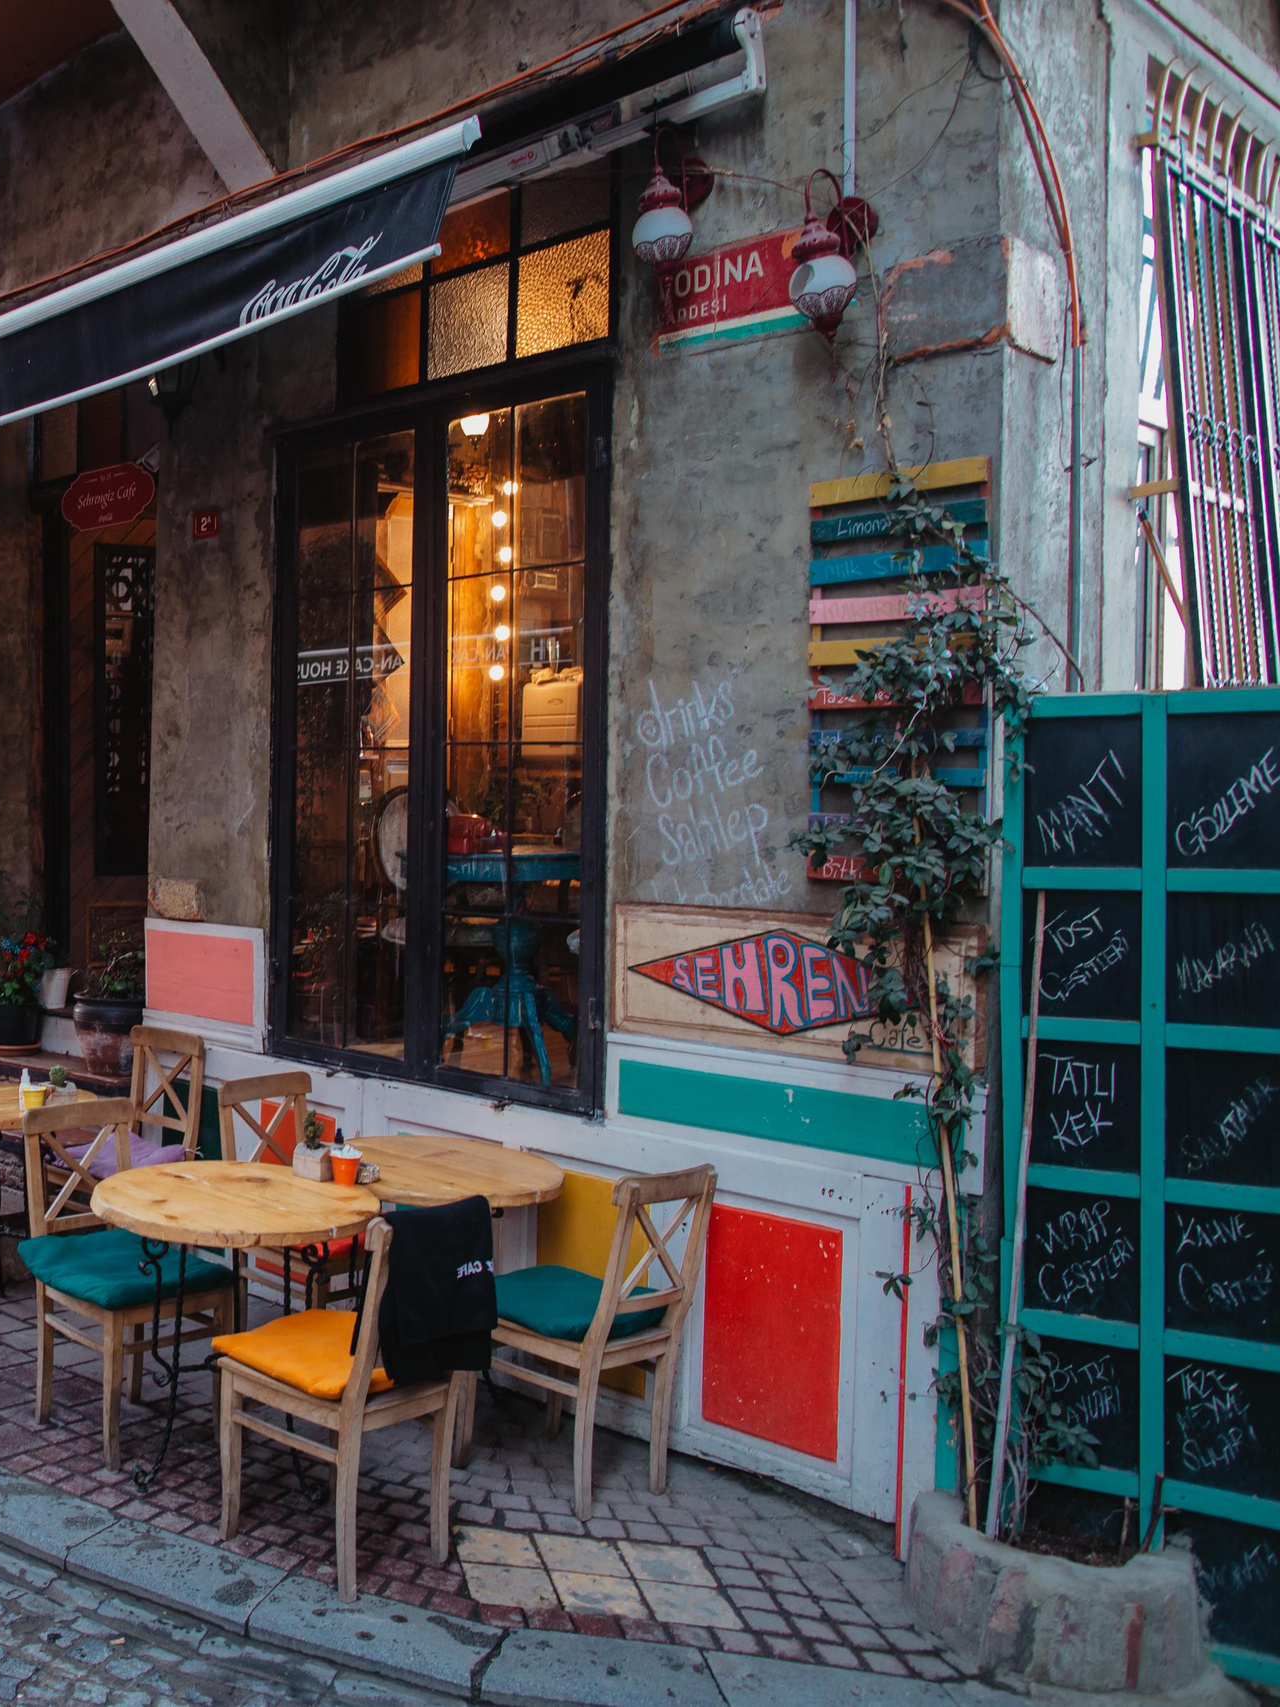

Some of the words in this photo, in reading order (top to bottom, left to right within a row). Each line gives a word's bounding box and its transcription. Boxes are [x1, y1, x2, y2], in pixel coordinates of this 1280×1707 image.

[637, 678, 734, 750] drinks
[646, 734, 763, 808] Coffee
[657, 793, 768, 867] Sahlep
[1030, 907, 1104, 954] TOST
[1039, 1053, 1116, 1104] TATLI
[1050, 1101, 1114, 1152] KEK
[1035, 1200, 1111, 1254] WRAP
[1175, 1211, 1255, 1254] KAHVE
